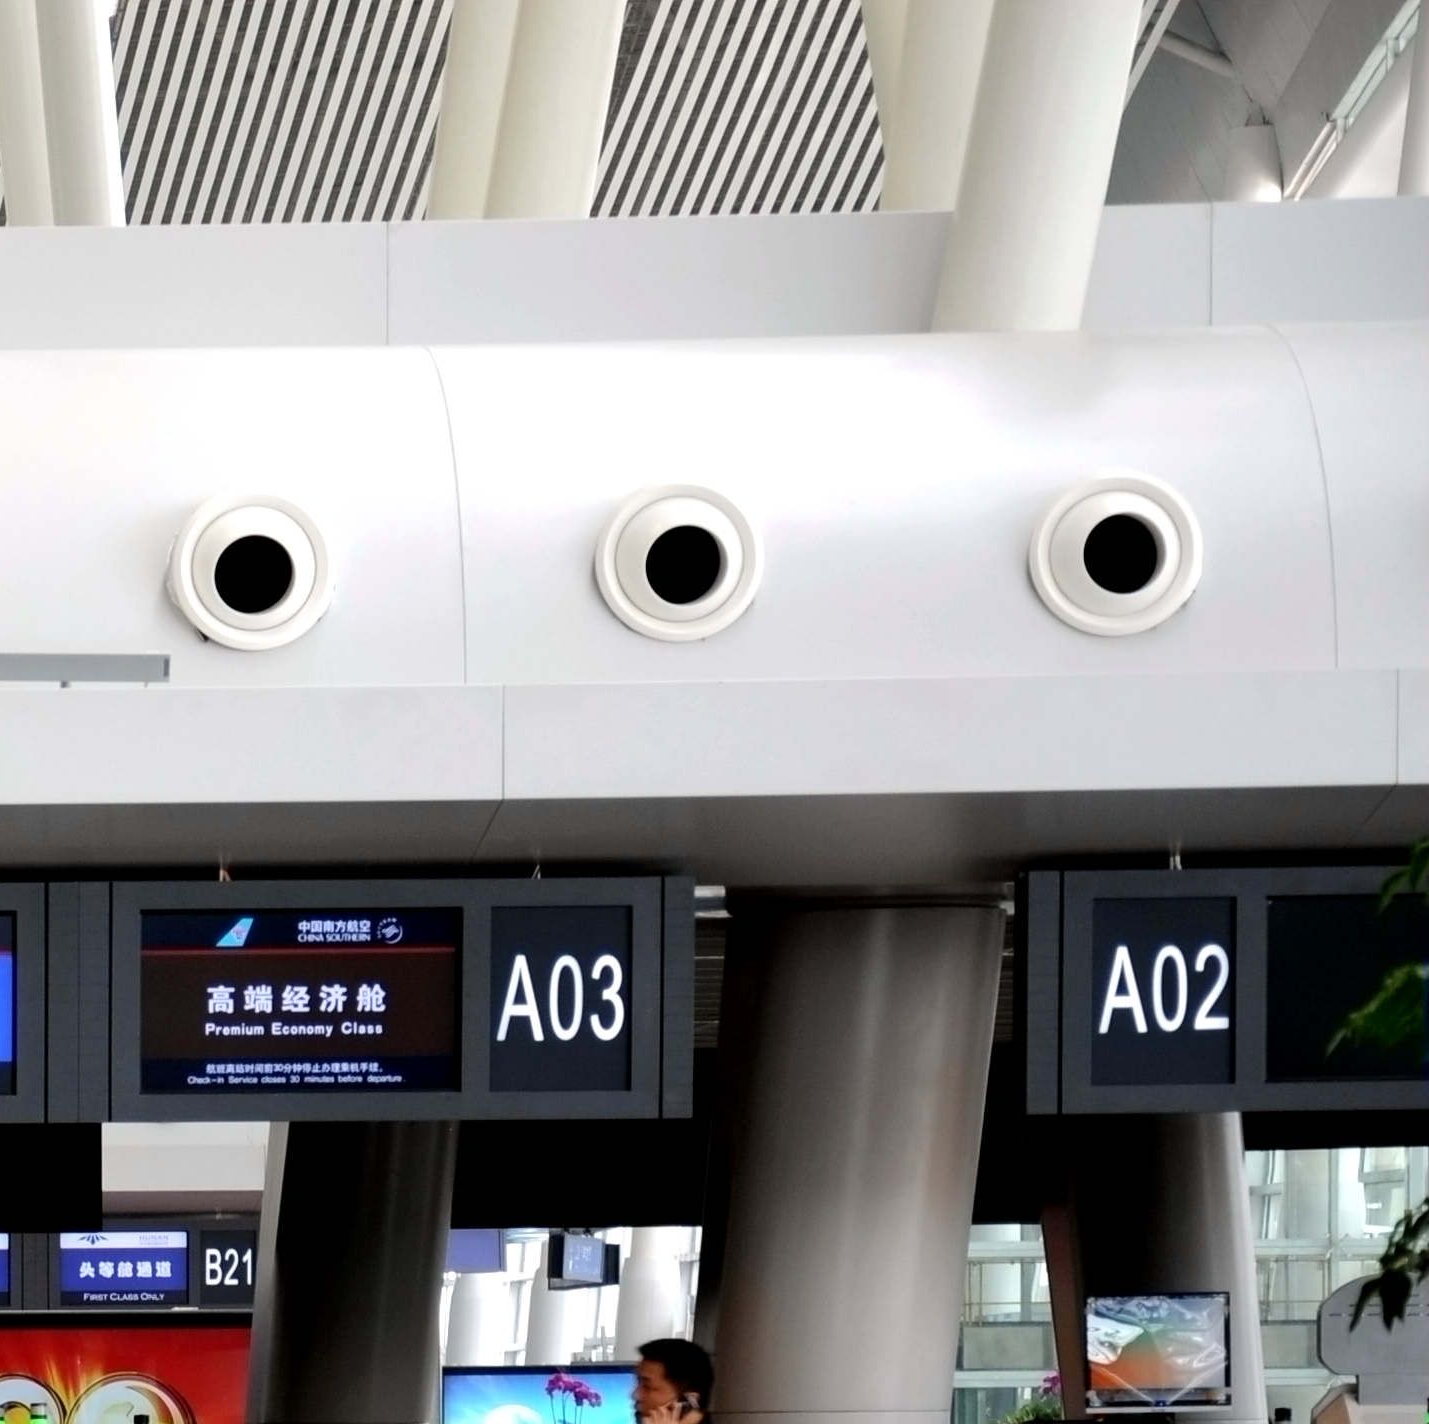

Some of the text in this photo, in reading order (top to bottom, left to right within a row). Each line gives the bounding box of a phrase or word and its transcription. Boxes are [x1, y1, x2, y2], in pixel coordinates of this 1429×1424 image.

[207, 984, 385, 1013] 高端经济舱
[497, 955, 624, 1041] A03
[1099, 944, 1229, 1033] A02
[205, 1022, 382, 1037] Premium Economy Class
[228, 1076, 258, 1084] Service
[290, 1075, 300, 1083] 30
[338, 1075, 363, 1083] before
[206, 1249, 251, 1285] B21
